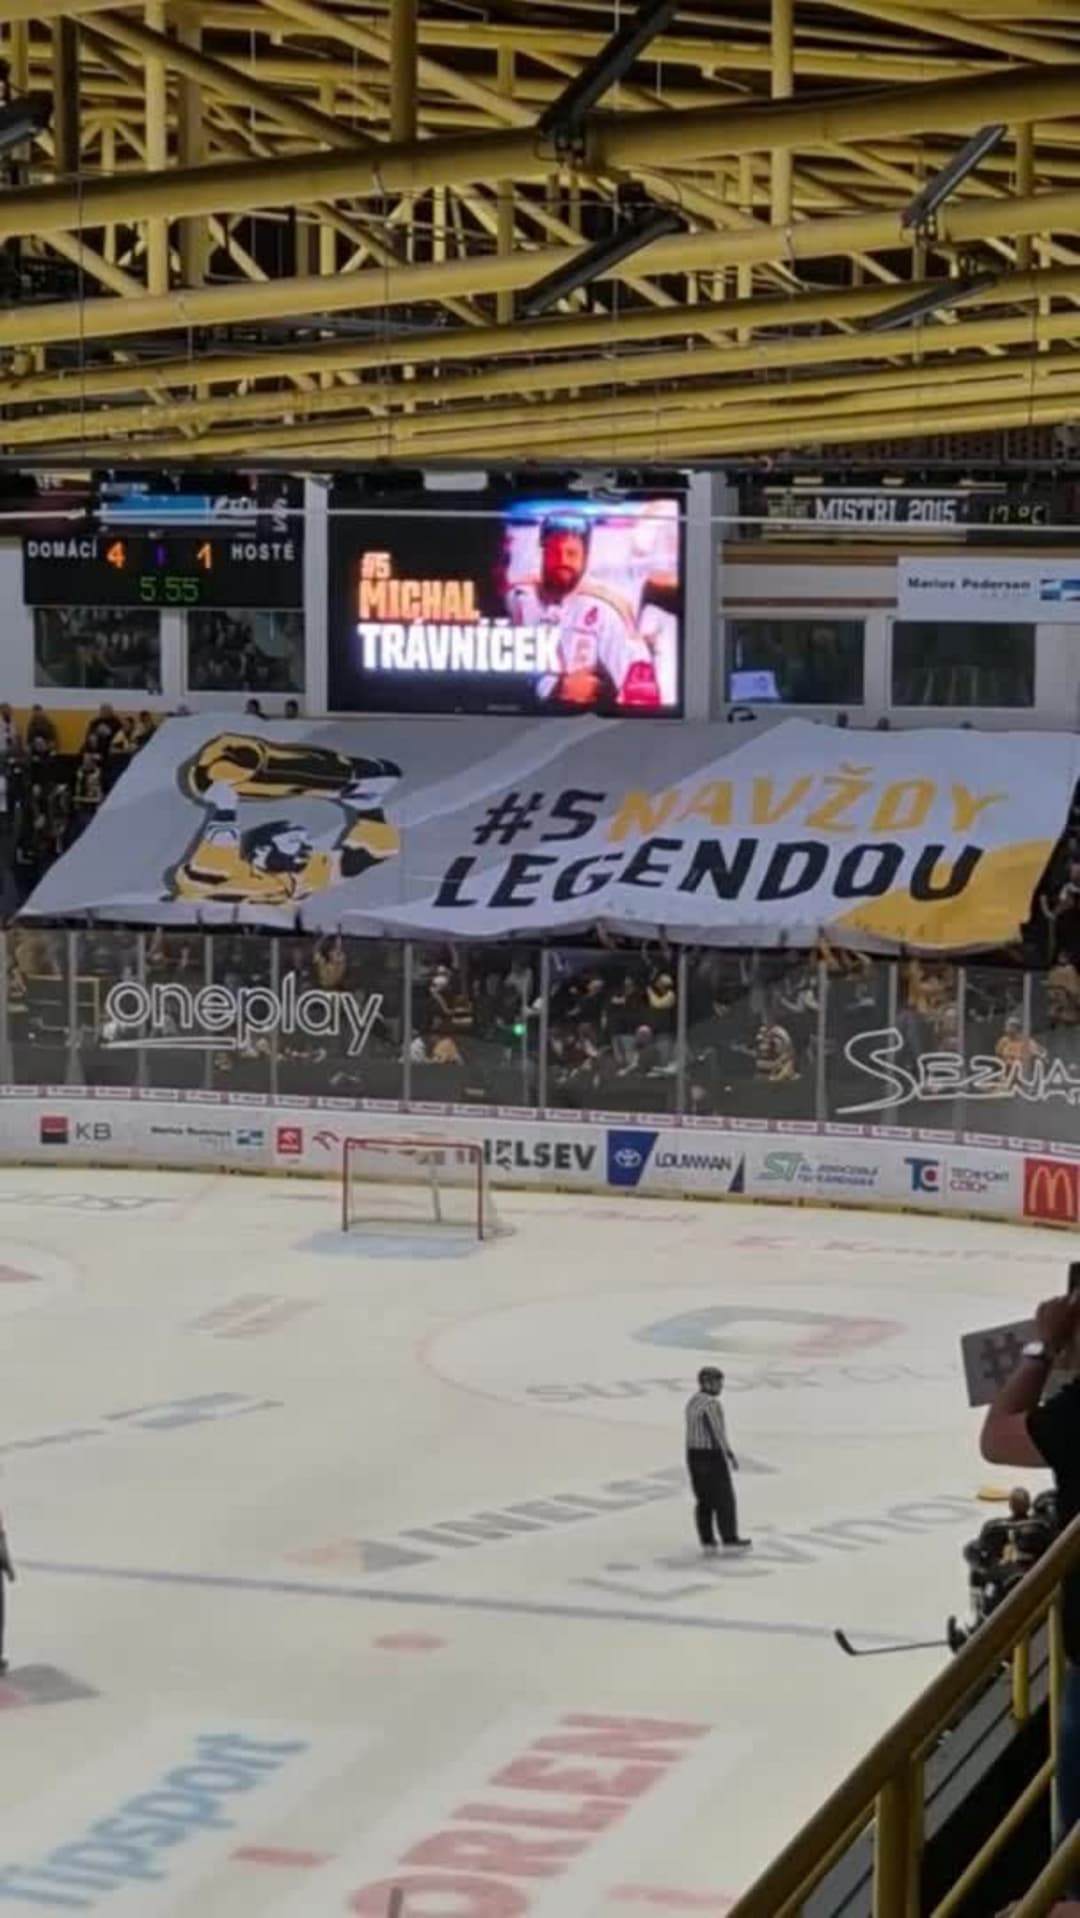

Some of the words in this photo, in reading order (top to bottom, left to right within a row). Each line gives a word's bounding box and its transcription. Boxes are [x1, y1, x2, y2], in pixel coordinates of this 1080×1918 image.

[907, 500, 957, 522] 2015
[27, 538, 97, 558] DOMÁCÍ
[106, 541, 126, 568] 4
[197, 542, 213, 569] 1
[231, 540, 294, 561] HOSTÉ
[361, 552, 391, 578] #5
[357, 617, 562, 672] TRÁVNÍČEK
[473, 789, 606, 846] #5
[605, 762, 1007, 842] NAVŽDY
[433, 838, 983, 909] LEGENDOU
[106, 971, 384, 1057] oneplay
[75, 1122, 112, 1141] KB
[345, 1713, 712, 1918] ORLEN
